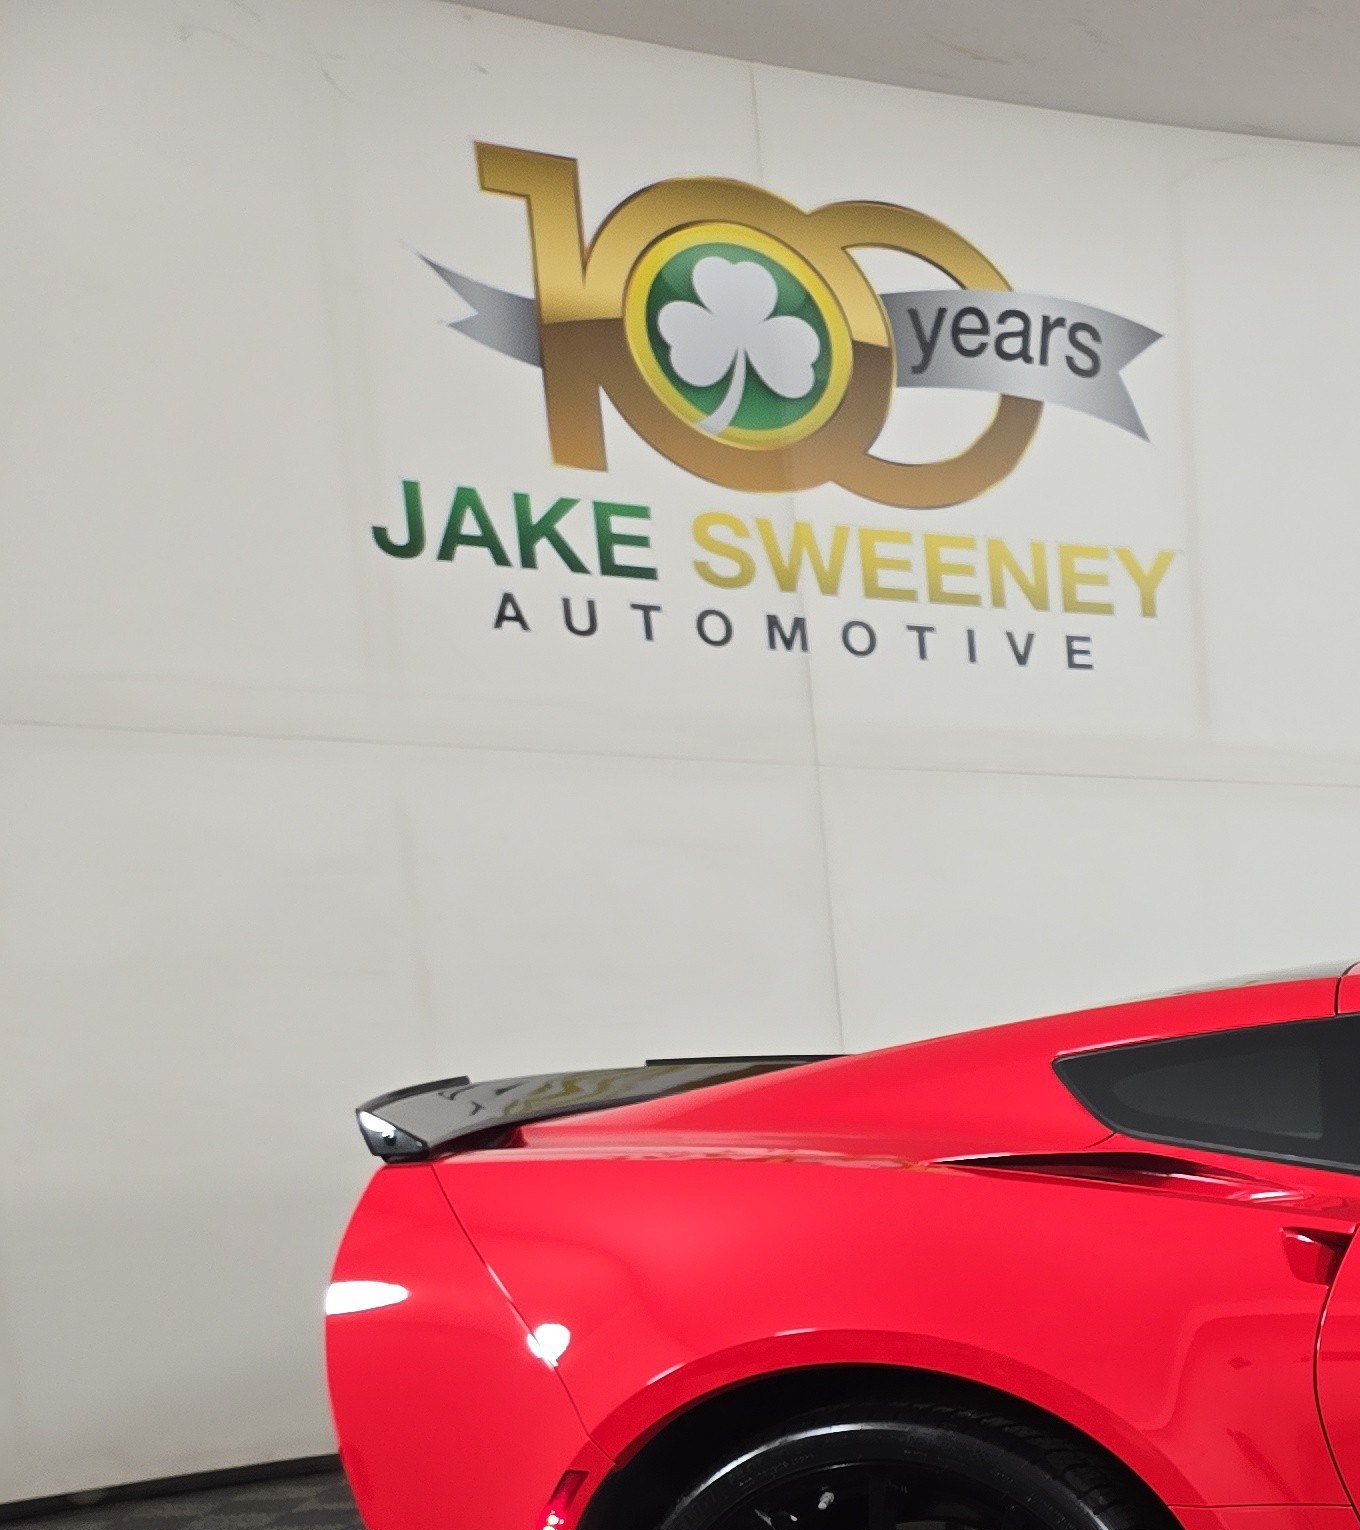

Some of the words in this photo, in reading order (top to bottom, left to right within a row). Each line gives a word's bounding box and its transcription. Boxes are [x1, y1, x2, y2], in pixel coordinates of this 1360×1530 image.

[474, 141, 1045, 509] 100
[904, 304, 1104, 379] years
[372, 480, 659, 581] JAKE
[690, 511, 1176, 619] SWEENEY
[493, 592, 1095, 670] AUTOMOTIVE
